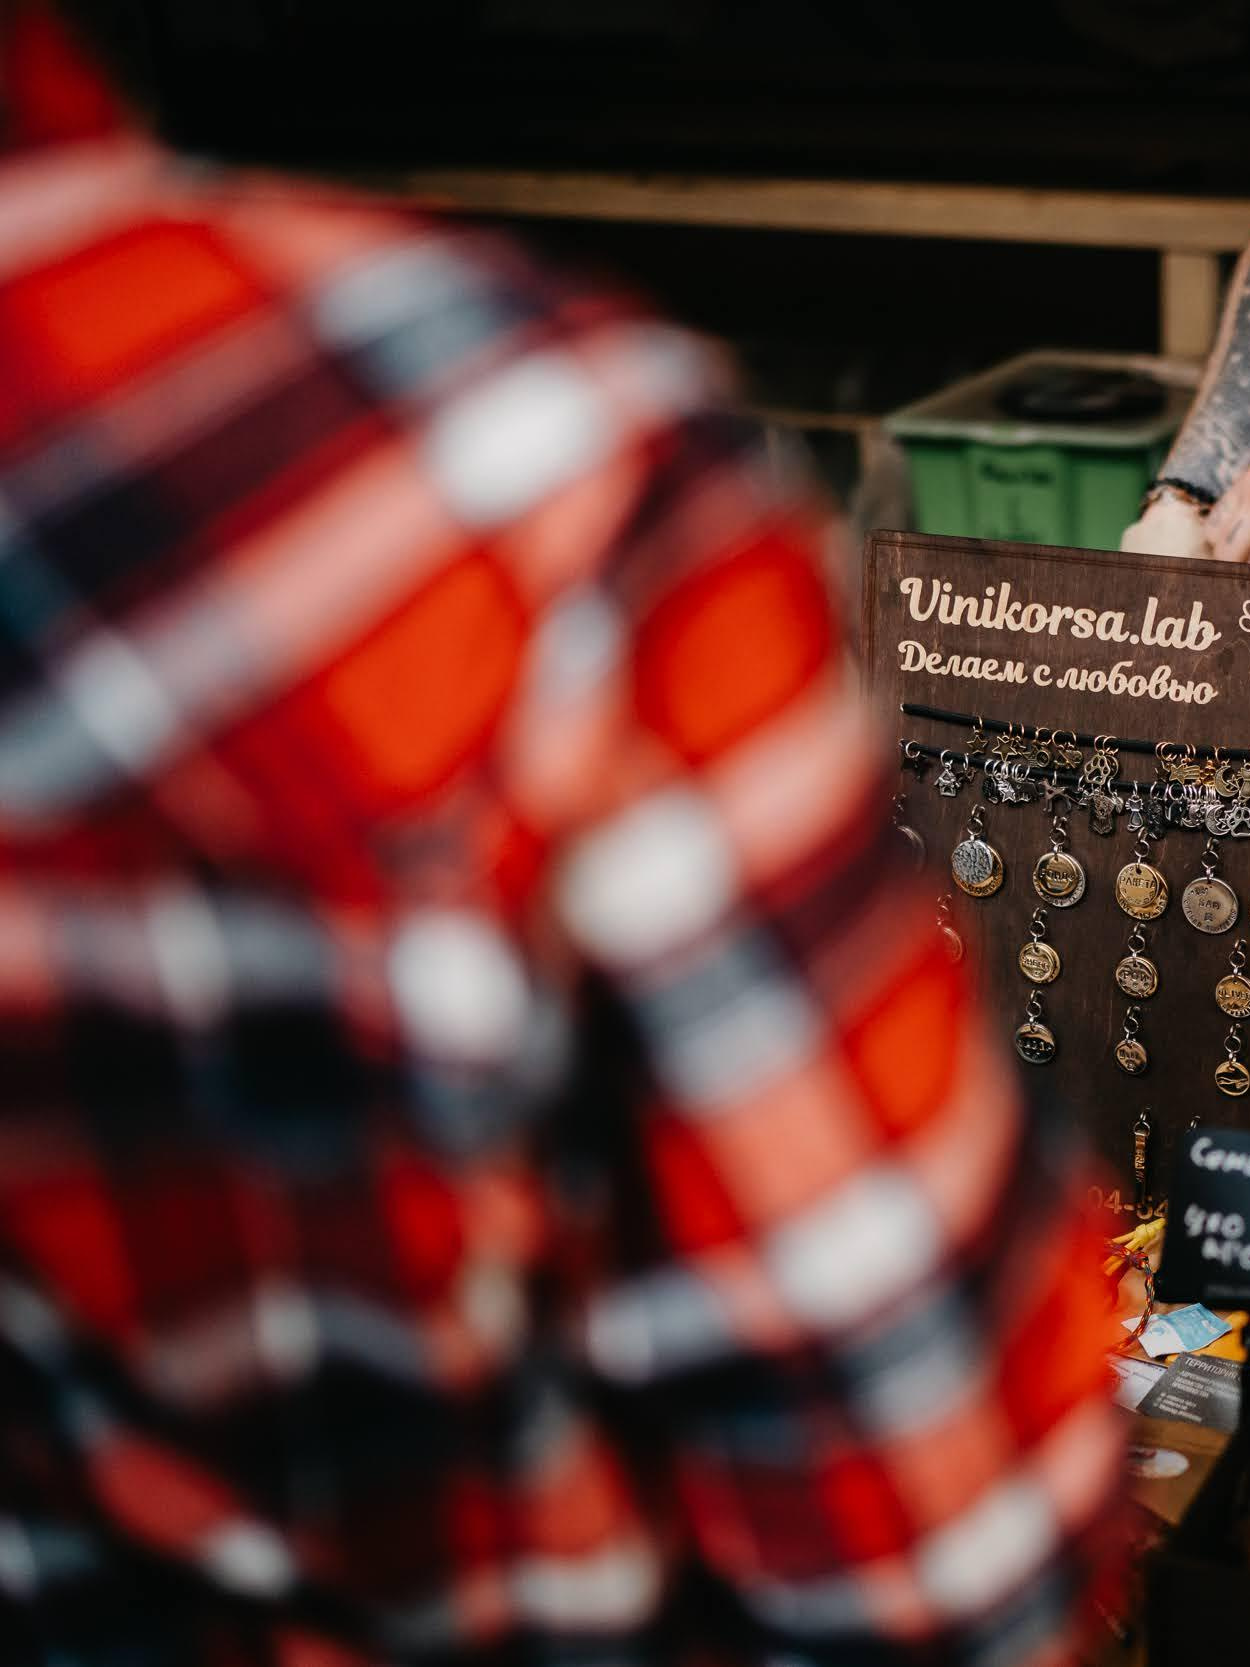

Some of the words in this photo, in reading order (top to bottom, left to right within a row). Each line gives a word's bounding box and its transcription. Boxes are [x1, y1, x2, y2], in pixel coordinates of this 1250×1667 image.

[899, 577, 1221, 651] Vinikorsa.lab
[897, 640, 1027, 684] Делаем
[1033, 664, 1053, 687] с
[1056, 660, 1218, 705] любовью
